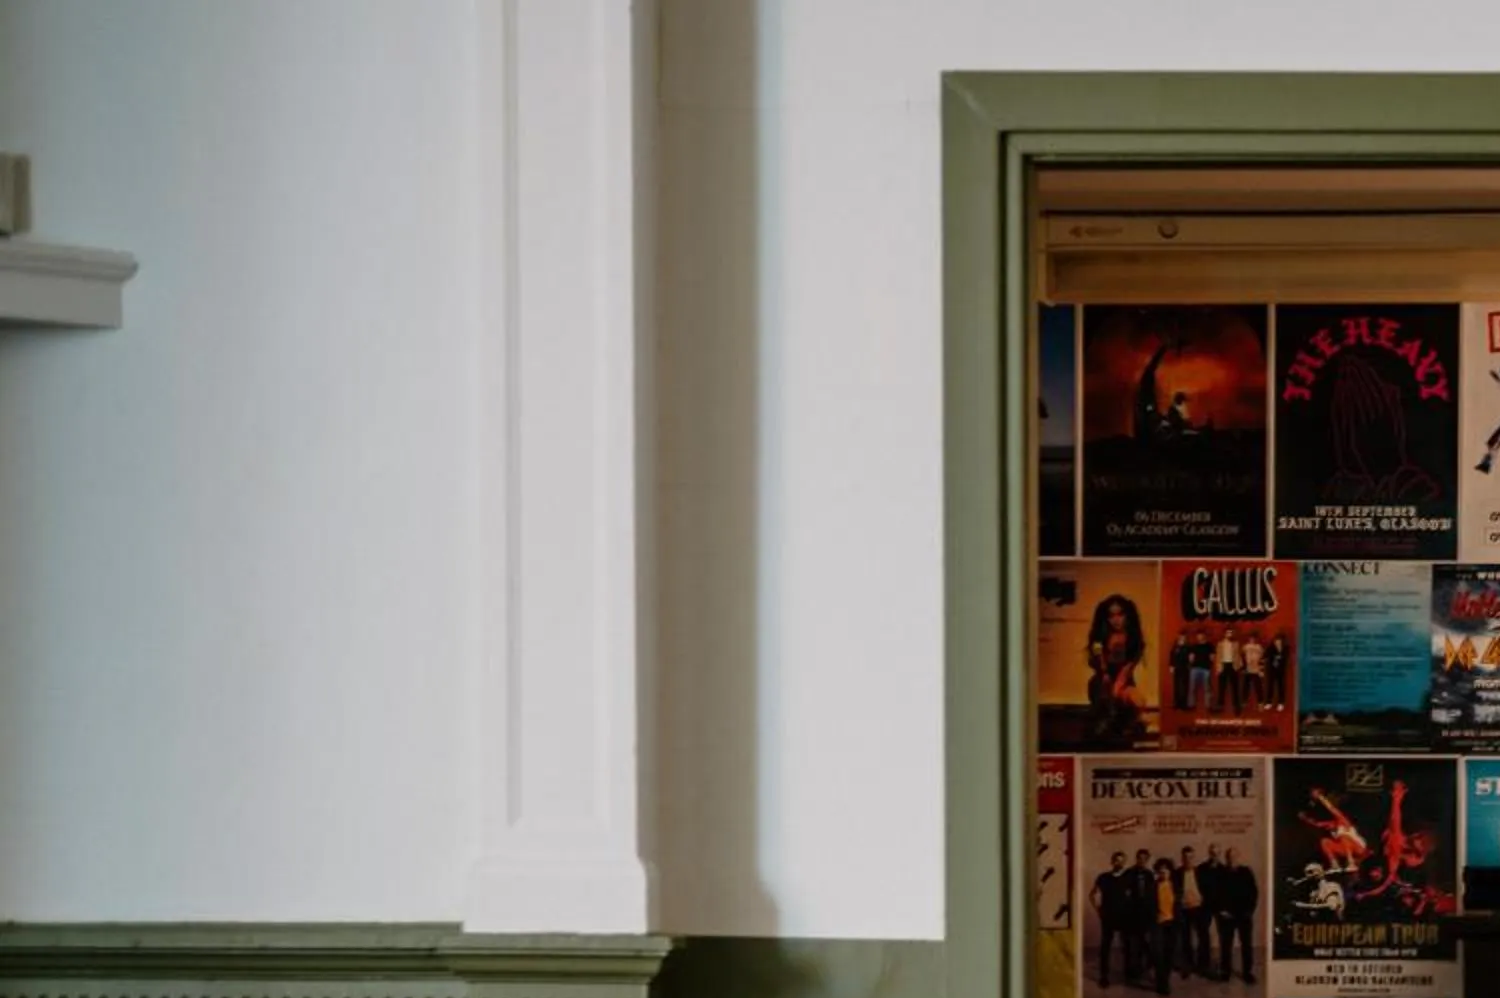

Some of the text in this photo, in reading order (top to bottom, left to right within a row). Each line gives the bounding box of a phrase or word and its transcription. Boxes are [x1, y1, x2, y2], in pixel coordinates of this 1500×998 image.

[1282, 316, 1453, 402] THE HEAVY
[1278, 517, 1322, 531] SAINT
[1379, 517, 1453, 532] GLASGOW
[1191, 566, 1281, 616] GALLUS
[1091, 781, 1255, 800] DEACON BLUE
